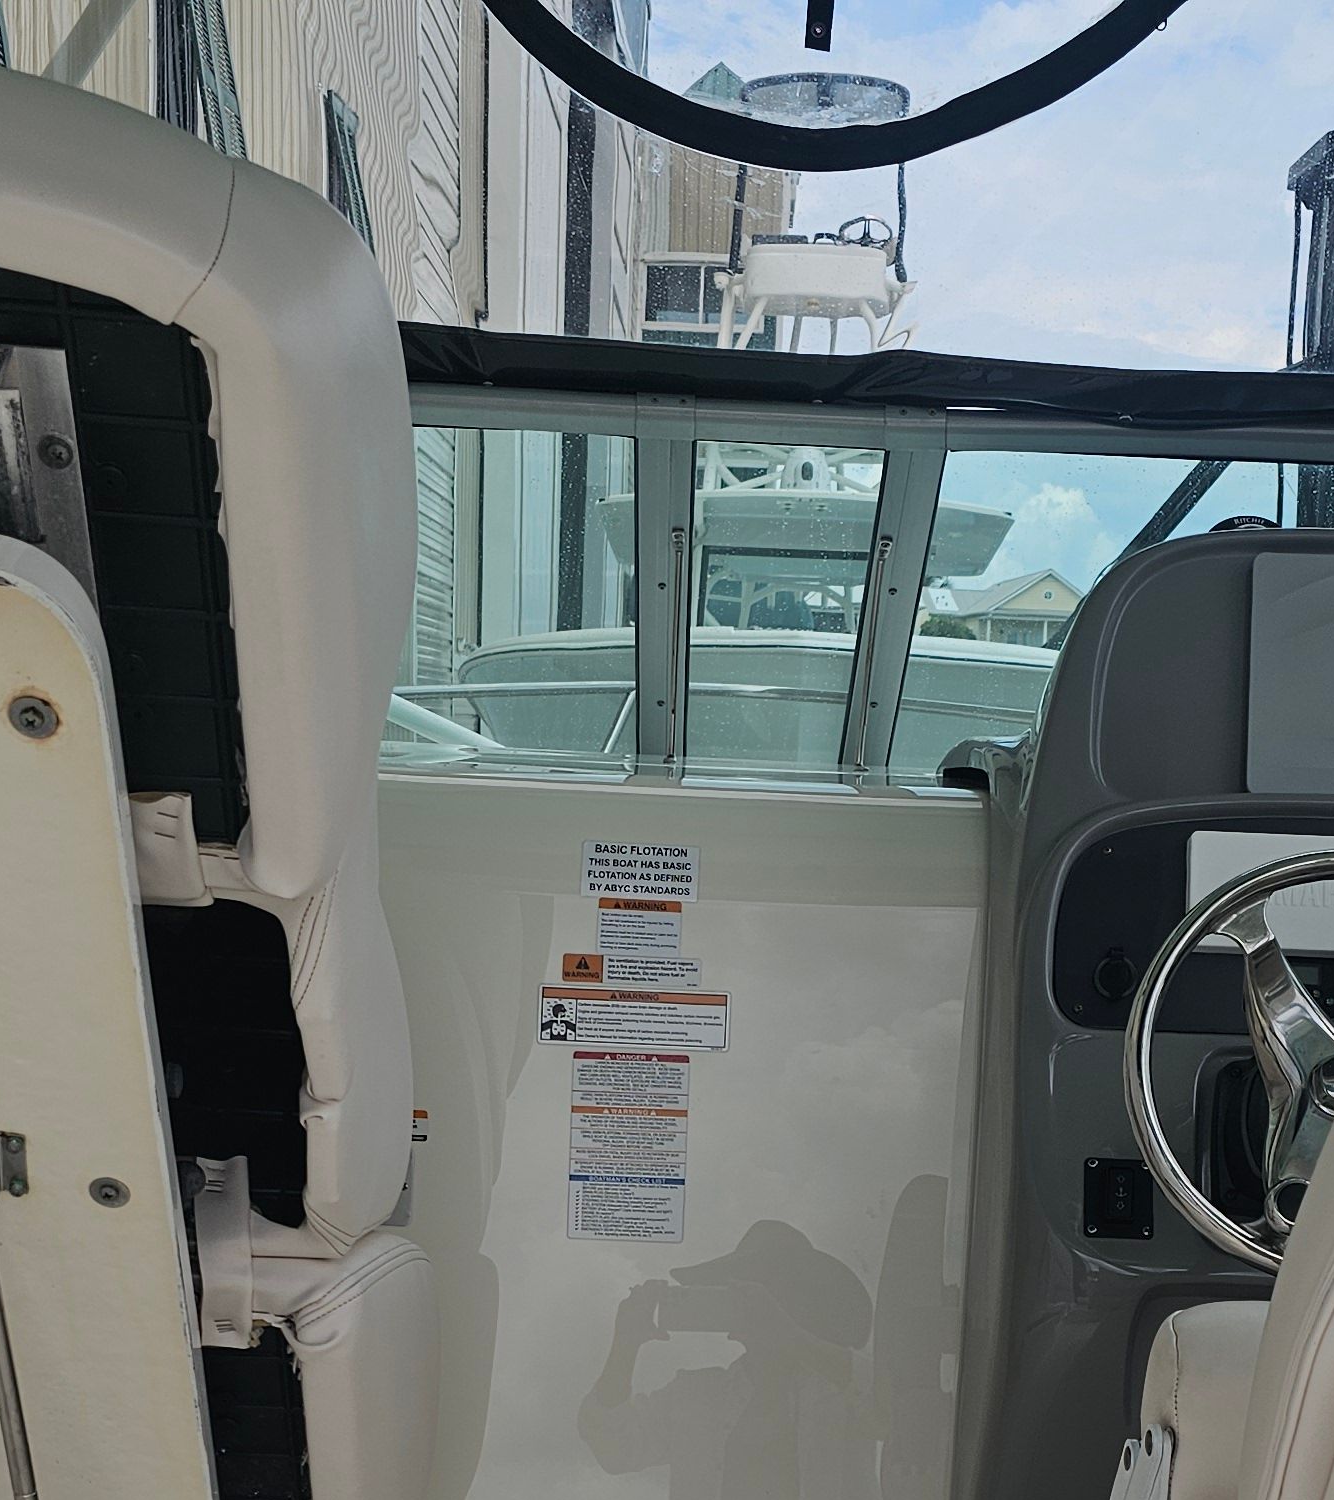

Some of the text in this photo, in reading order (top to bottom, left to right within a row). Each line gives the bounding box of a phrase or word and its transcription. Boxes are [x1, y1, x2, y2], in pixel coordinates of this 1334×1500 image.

[595, 844, 688, 857] BASIC FLOTATION
[589, 857, 692, 871] THIS BOAT HAS BASIC
[587, 870, 692, 883] FLOTATION AS DEFINED
[589, 883, 690, 896] BY ABYC STANDARDS
[623, 901, 667, 911] WARNING
[564, 971, 600, 979] WARNING
[618, 993, 659, 1001] WARNING
[611, 1108, 649, 1116] WARNING
